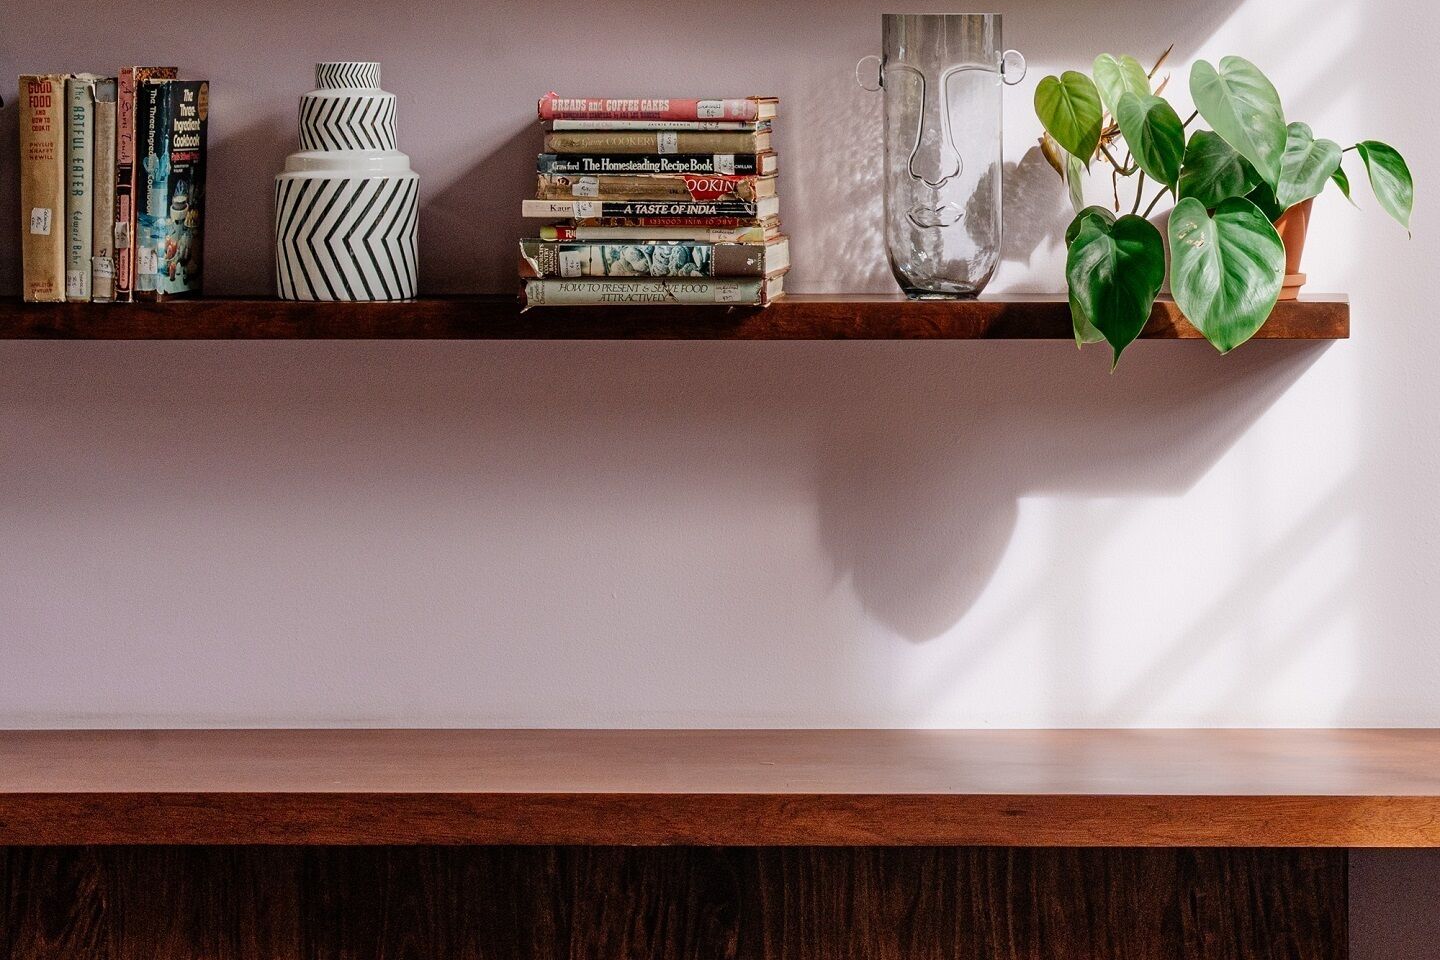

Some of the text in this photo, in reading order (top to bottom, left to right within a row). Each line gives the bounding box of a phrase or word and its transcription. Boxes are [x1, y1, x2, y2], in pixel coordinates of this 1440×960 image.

[28, 81, 52, 94] GOOD
[29, 96, 51, 108] FOOD
[150, 89, 158, 104] The
[183, 89, 193, 102] The
[552, 99, 669, 112] BREADS and COFFEE CAKES
[174, 118, 200, 134] Ingredient
[173, 134, 200, 148] Cookbook
[551, 158, 713, 172] Crawford The Homesteading Recipe Book
[72, 86, 85, 265] The ARTFUL EATER Edward Behr
[624, 205, 631, 214] A
[634, 205, 672, 214] TASTE
[673, 205, 687, 214] OF
[688, 205, 717, 214] INDIA
[559, 284, 585, 292] HOW
[597, 294, 668, 302] ATTRACTIVELY
